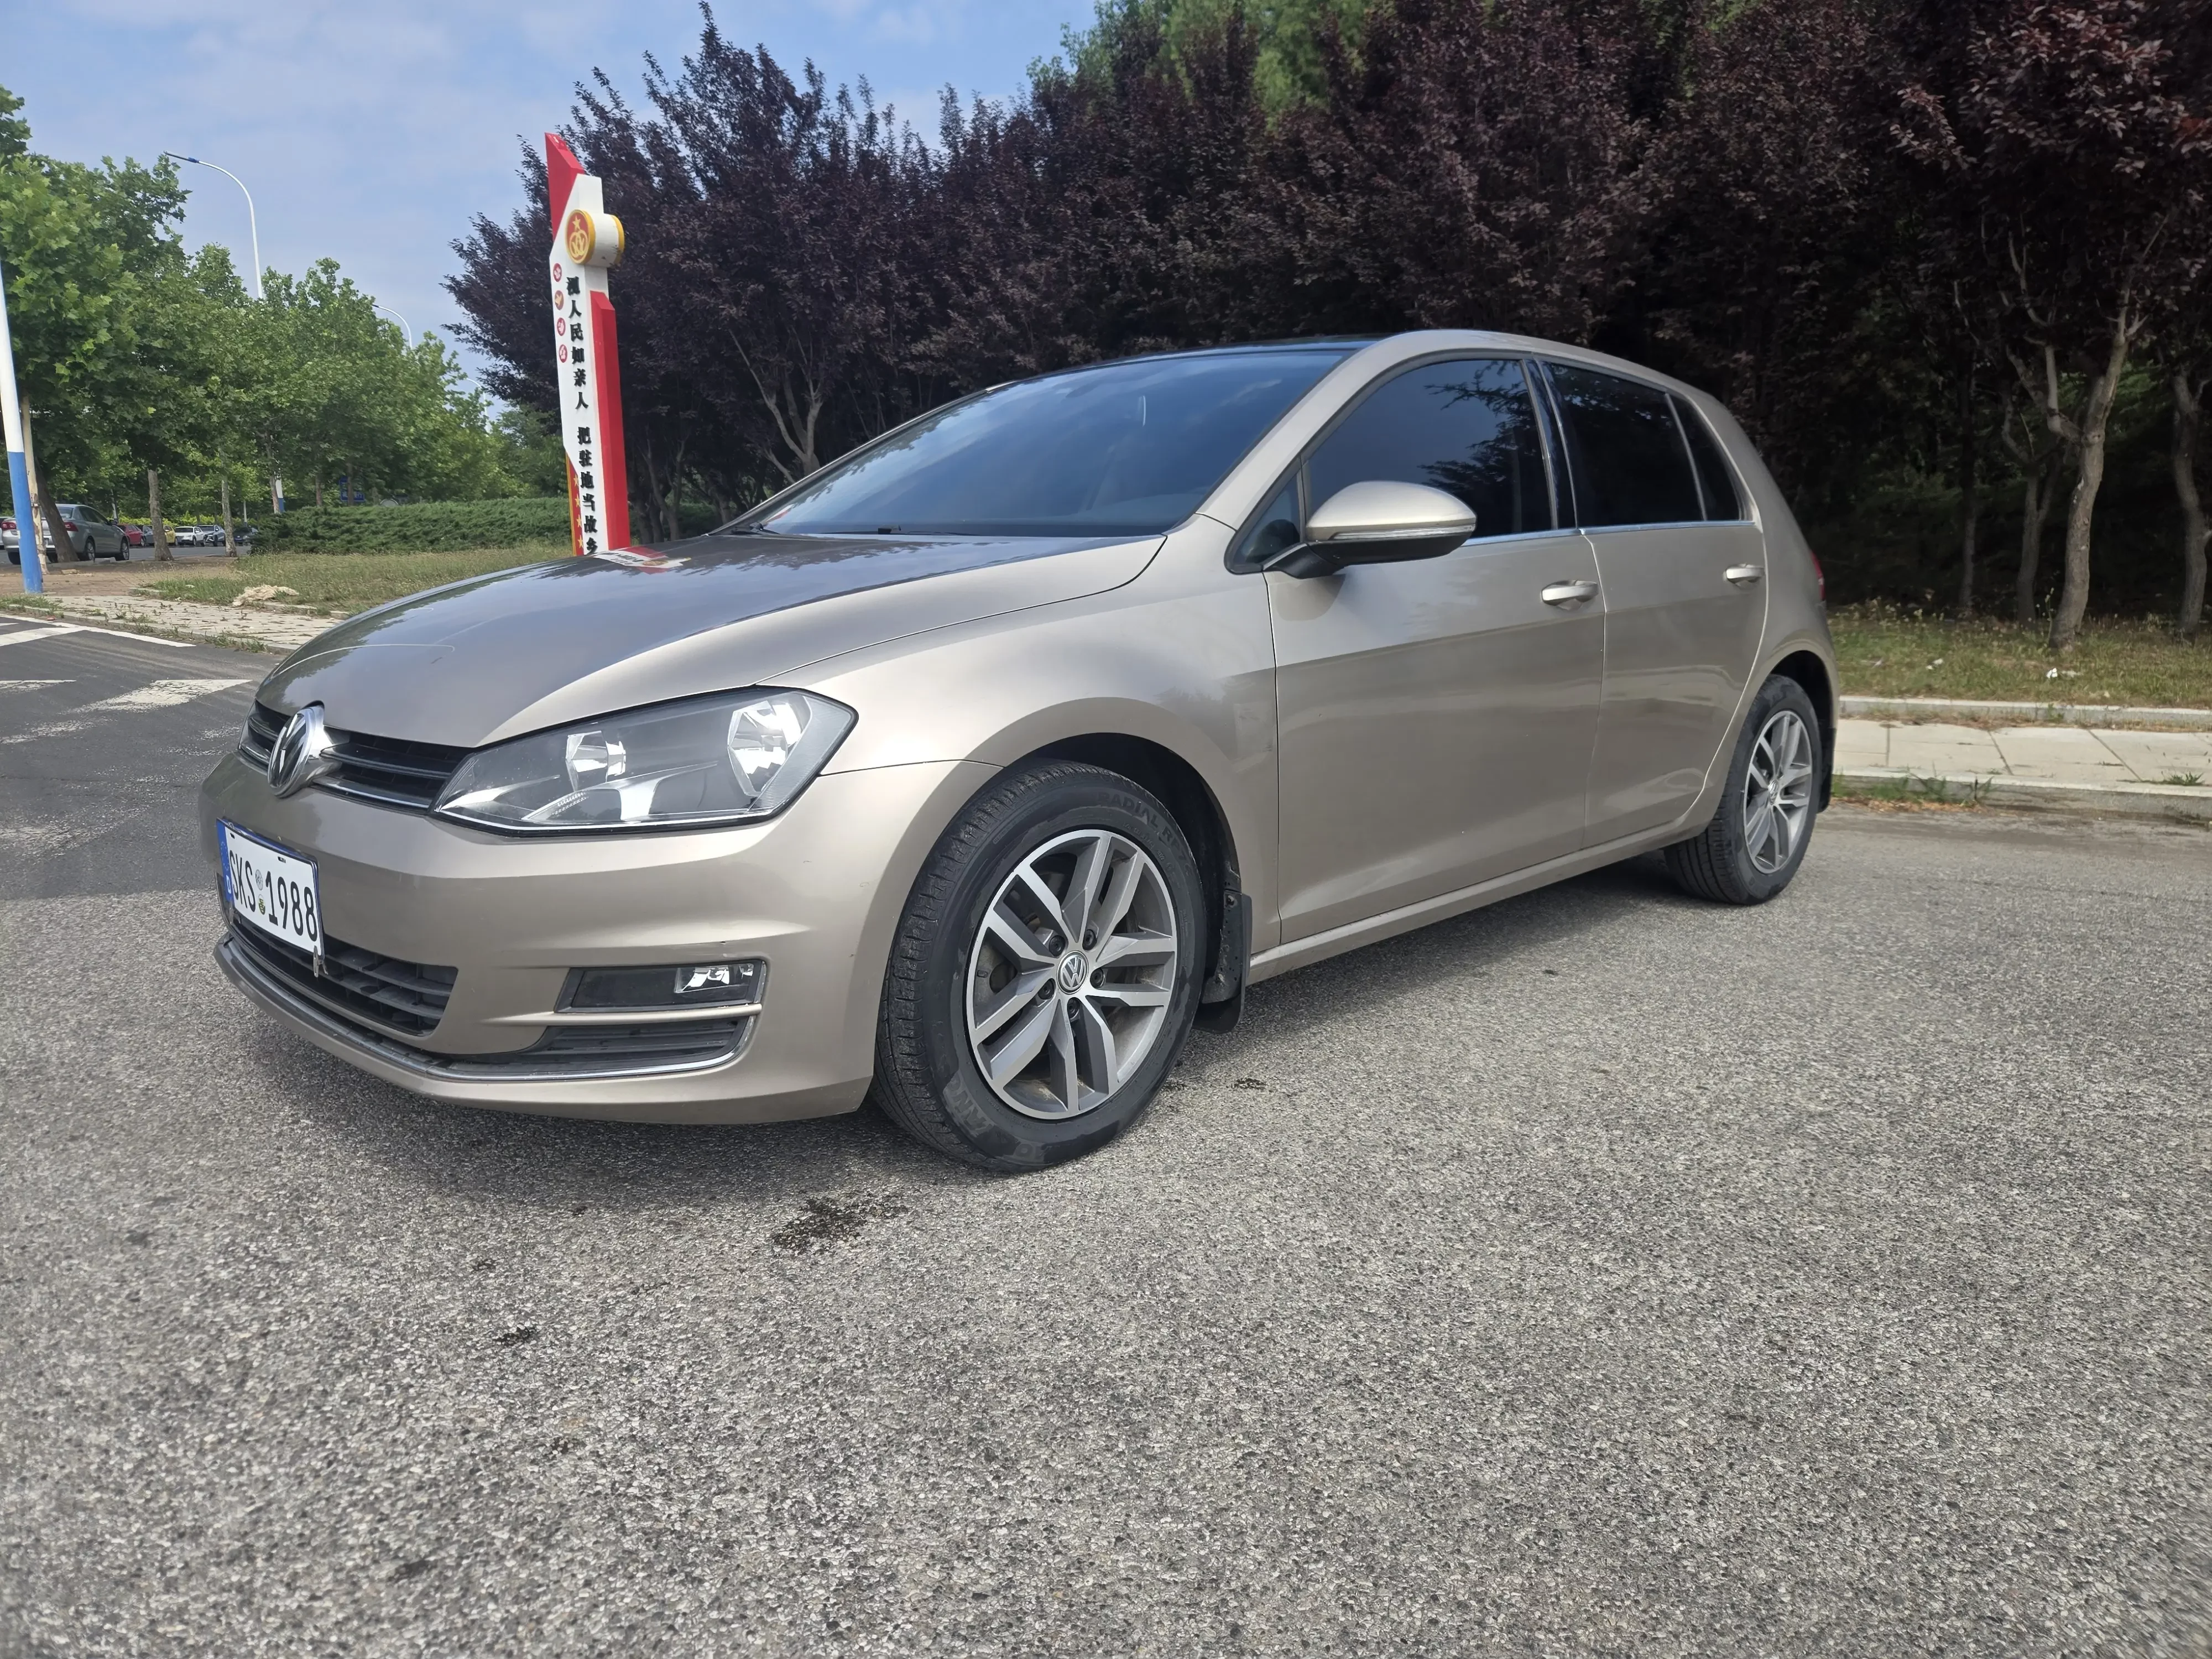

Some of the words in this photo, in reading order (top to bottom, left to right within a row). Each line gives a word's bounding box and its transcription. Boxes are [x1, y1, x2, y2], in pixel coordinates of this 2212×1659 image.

[577, 426, 598, 555] 把驻地当故乡
[229, 850, 256, 912] SKS
[265, 870, 318, 942] 1988
